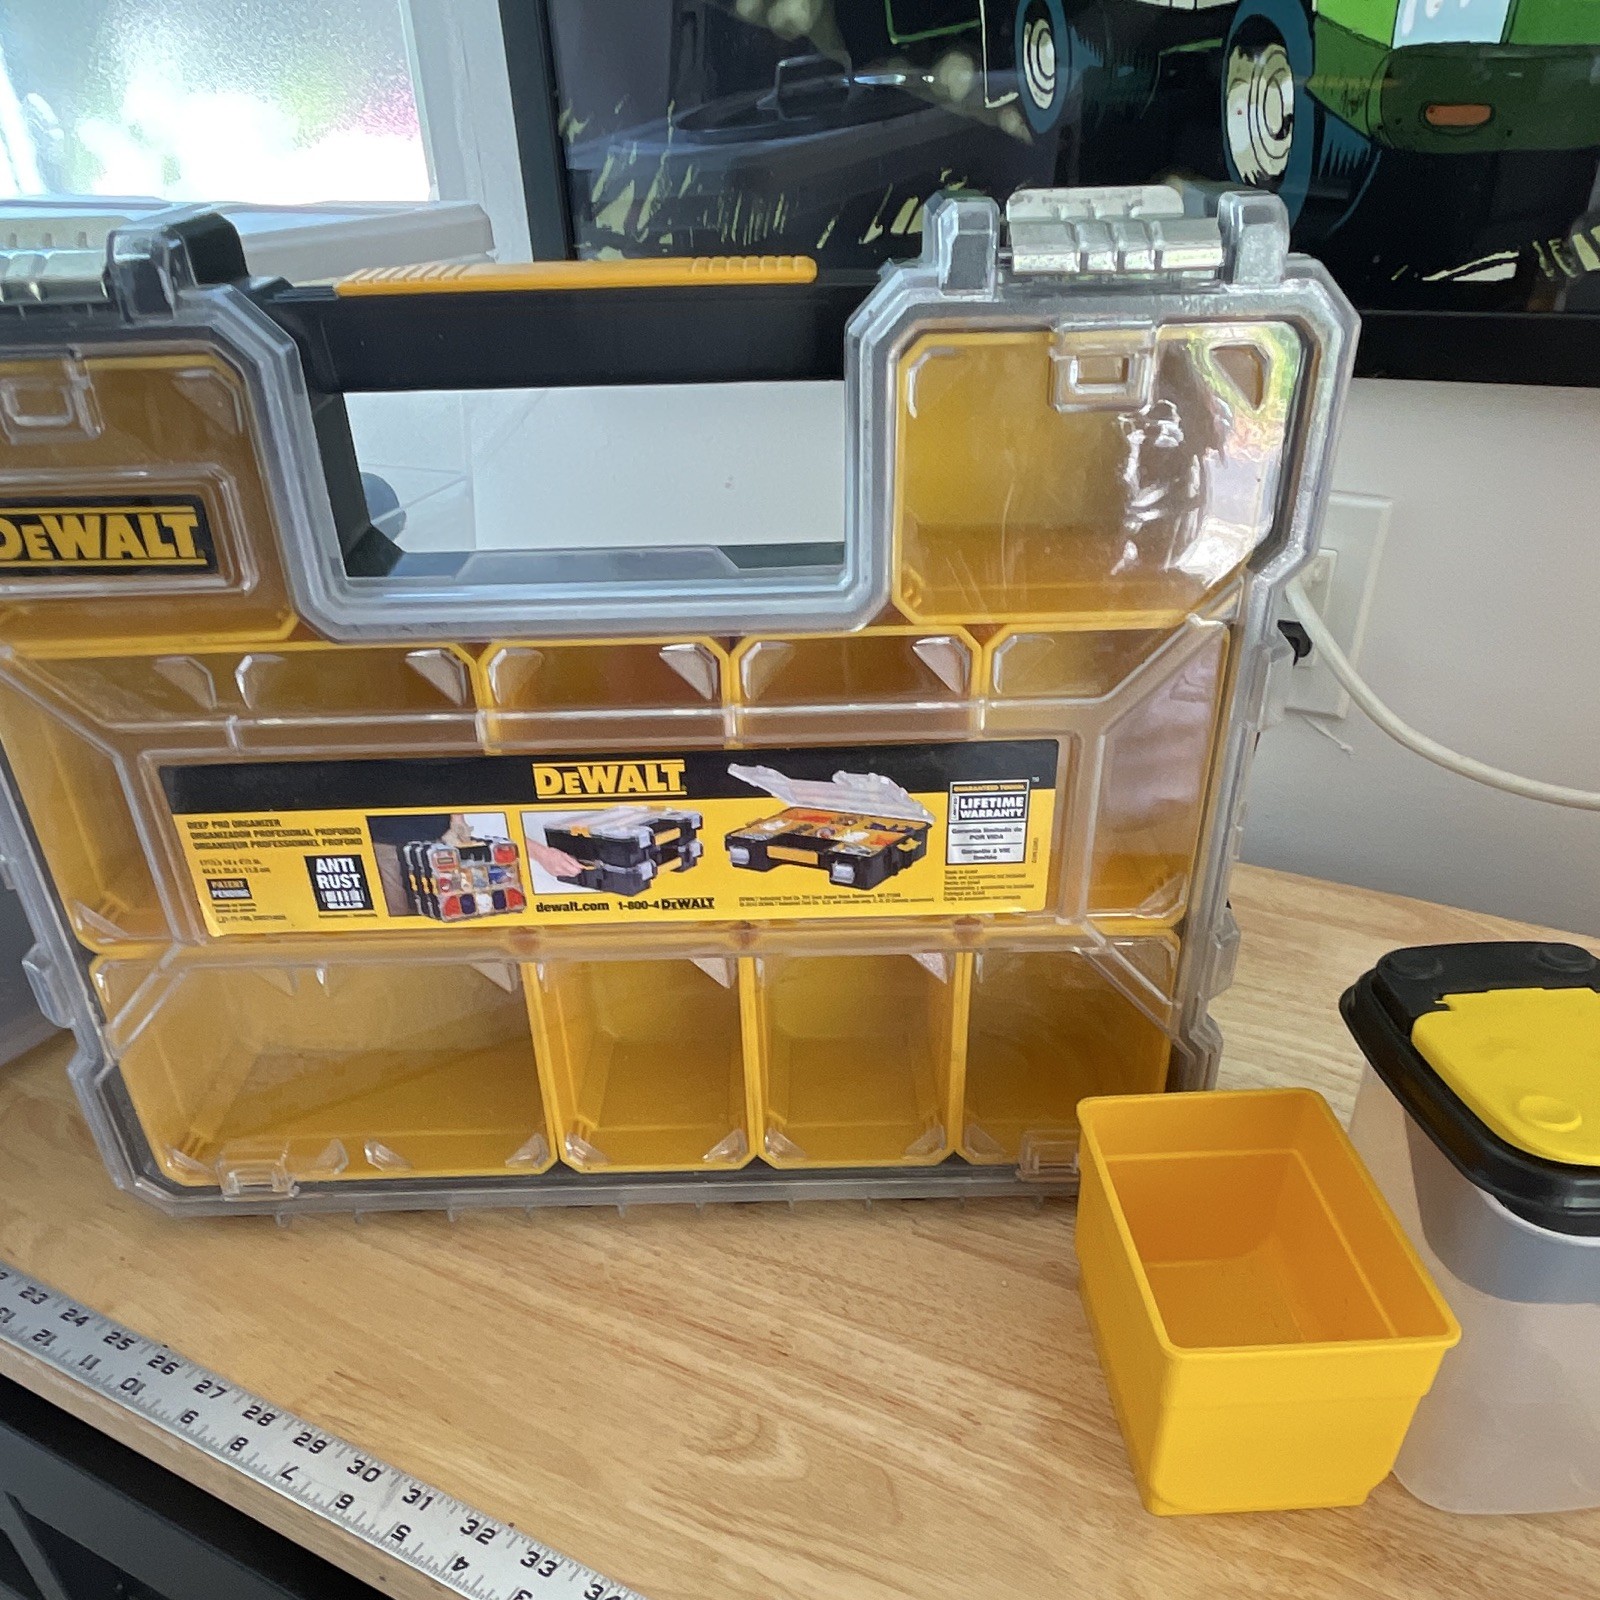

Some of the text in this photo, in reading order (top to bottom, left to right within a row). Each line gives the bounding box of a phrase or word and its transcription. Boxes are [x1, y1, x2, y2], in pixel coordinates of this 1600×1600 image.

[533, 760, 687, 798] DEWALT
[960, 796, 1024, 809] LIFETIME
[960, 808, 1023, 818] WARRANTY
[211, 820, 230, 829] PRO
[231, 819, 282, 828] ORGANIZER
[316, 857, 356, 873] ANTI
[315, 873, 361, 889] RUST
[536, 901, 609, 912] dewalt.com
[32, 1329, 57, 1346] 12
[79, 1354, 101, 1370] 11
[119, 1377, 147, 1396] 10
[180, 1410, 199, 1424] 9
[19, 1286, 48, 1304] 23
[59, 1308, 89, 1327] 24
[103, 1331, 135, 1351] 25
[147, 1355, 180, 1375] 26
[193, 1379, 227, 1399] 27
[242, 1404, 277, 1427] 28
[293, 1432, 328, 1454] 29
[347, 1459, 382, 1483] 30
[402, 1488, 435, 1511] 31
[460, 1519, 496, 1545] 32
[520, 1551, 558, 1577] 33
[230, 1436, 249, 1452] 8
[281, 1465, 299, 1481] 7
[336, 1493, 354, 1510] 6
[391, 1524, 412, 1542] 5
[451, 1556, 470, 1572] 4
